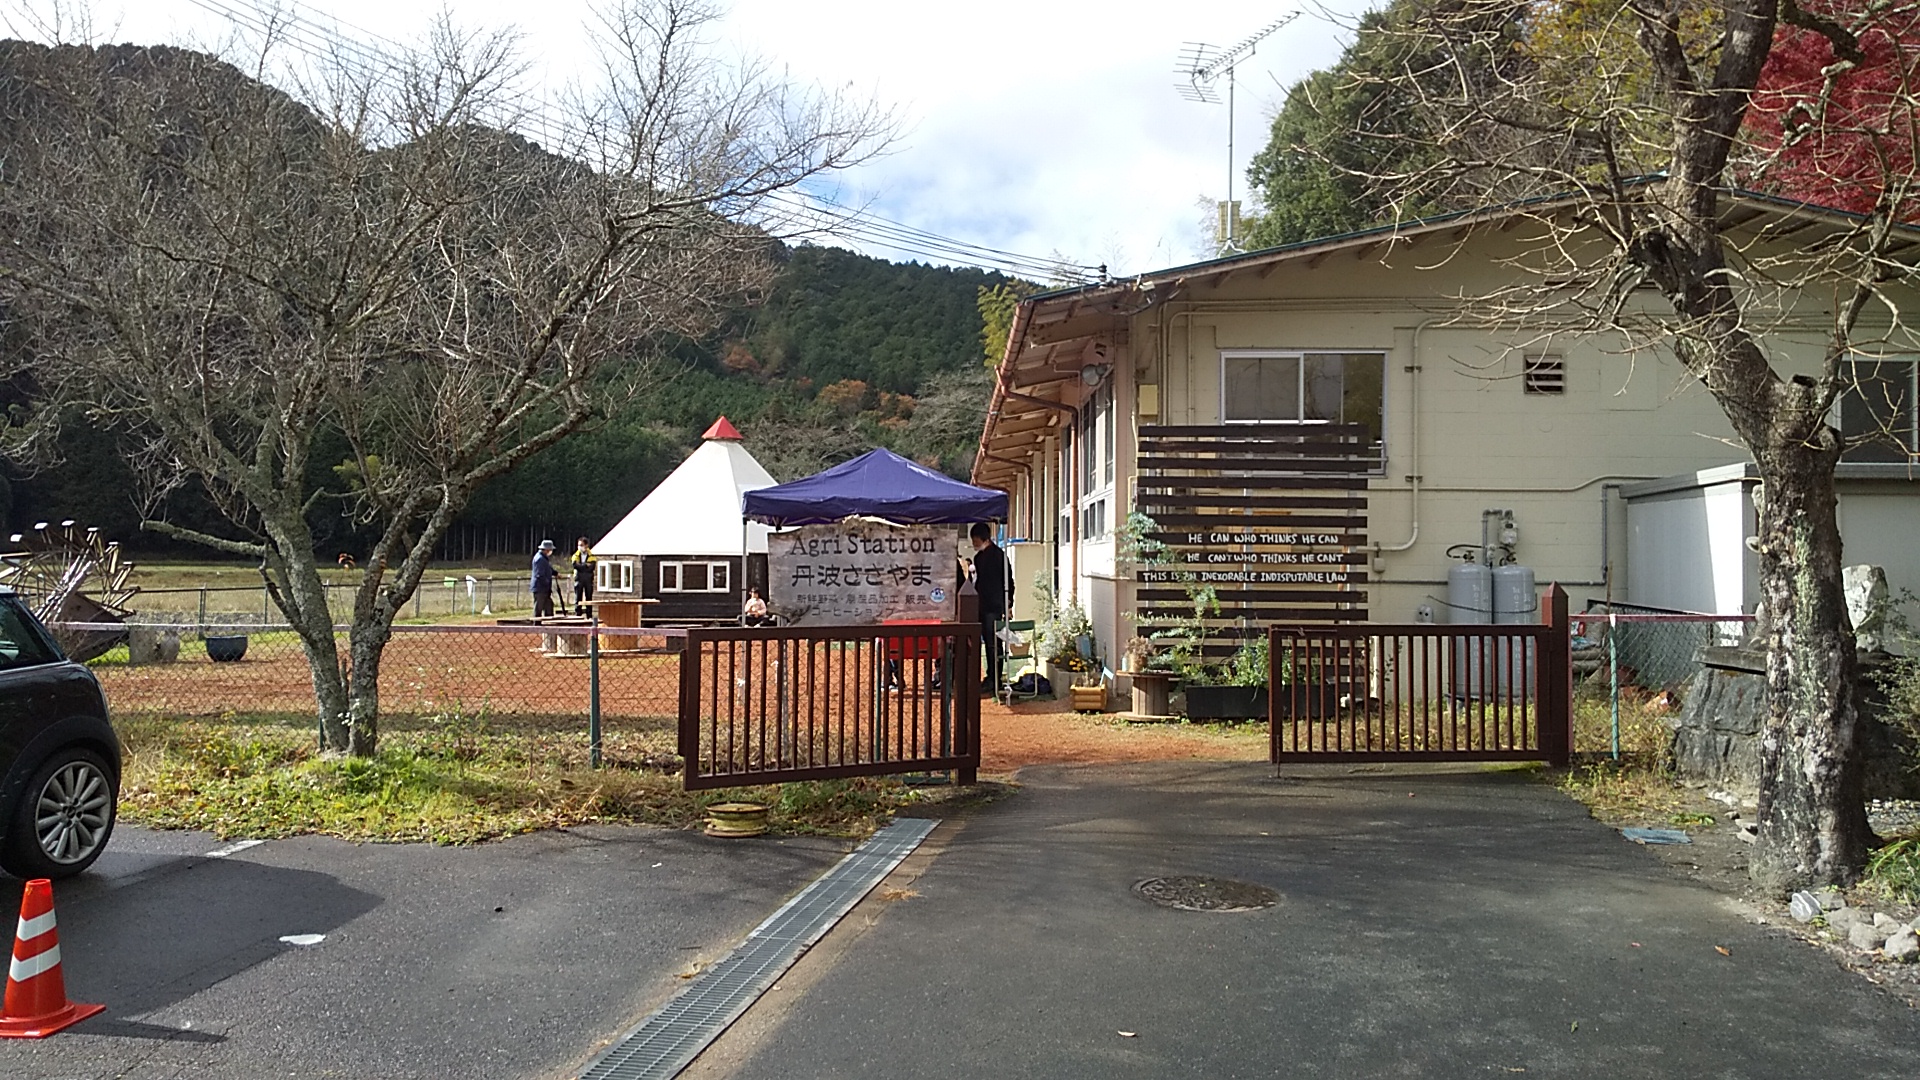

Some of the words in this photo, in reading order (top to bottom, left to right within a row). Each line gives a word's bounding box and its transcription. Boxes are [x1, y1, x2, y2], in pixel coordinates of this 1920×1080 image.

[1188, 533, 1203, 543] HE
[1210, 532, 1230, 543] CAN
[1234, 534, 1257, 543] WHO
[1260, 533, 1298, 544] THINKS
[1302, 534, 1316, 544] HE
[1318, 534, 1339, 544] CAN
[790, 535, 842, 557] Agri
[847, 533, 936, 555] Station
[1187, 553, 1200, 562] HE
[1233, 554, 1258, 563] WHO
[1261, 554, 1297, 563] THINKS
[1301, 554, 1315, 563] HE
[792, 563, 932, 587] 丹波ささやま
[1143, 572, 1167, 582] THIS
[1171, 572, 1180, 581] IS
[1201, 572, 1257, 582] INEXORABLE
[1260, 572, 1324, 582] INDISPUTABLE
[1325, 572, 1348, 583] LAW
